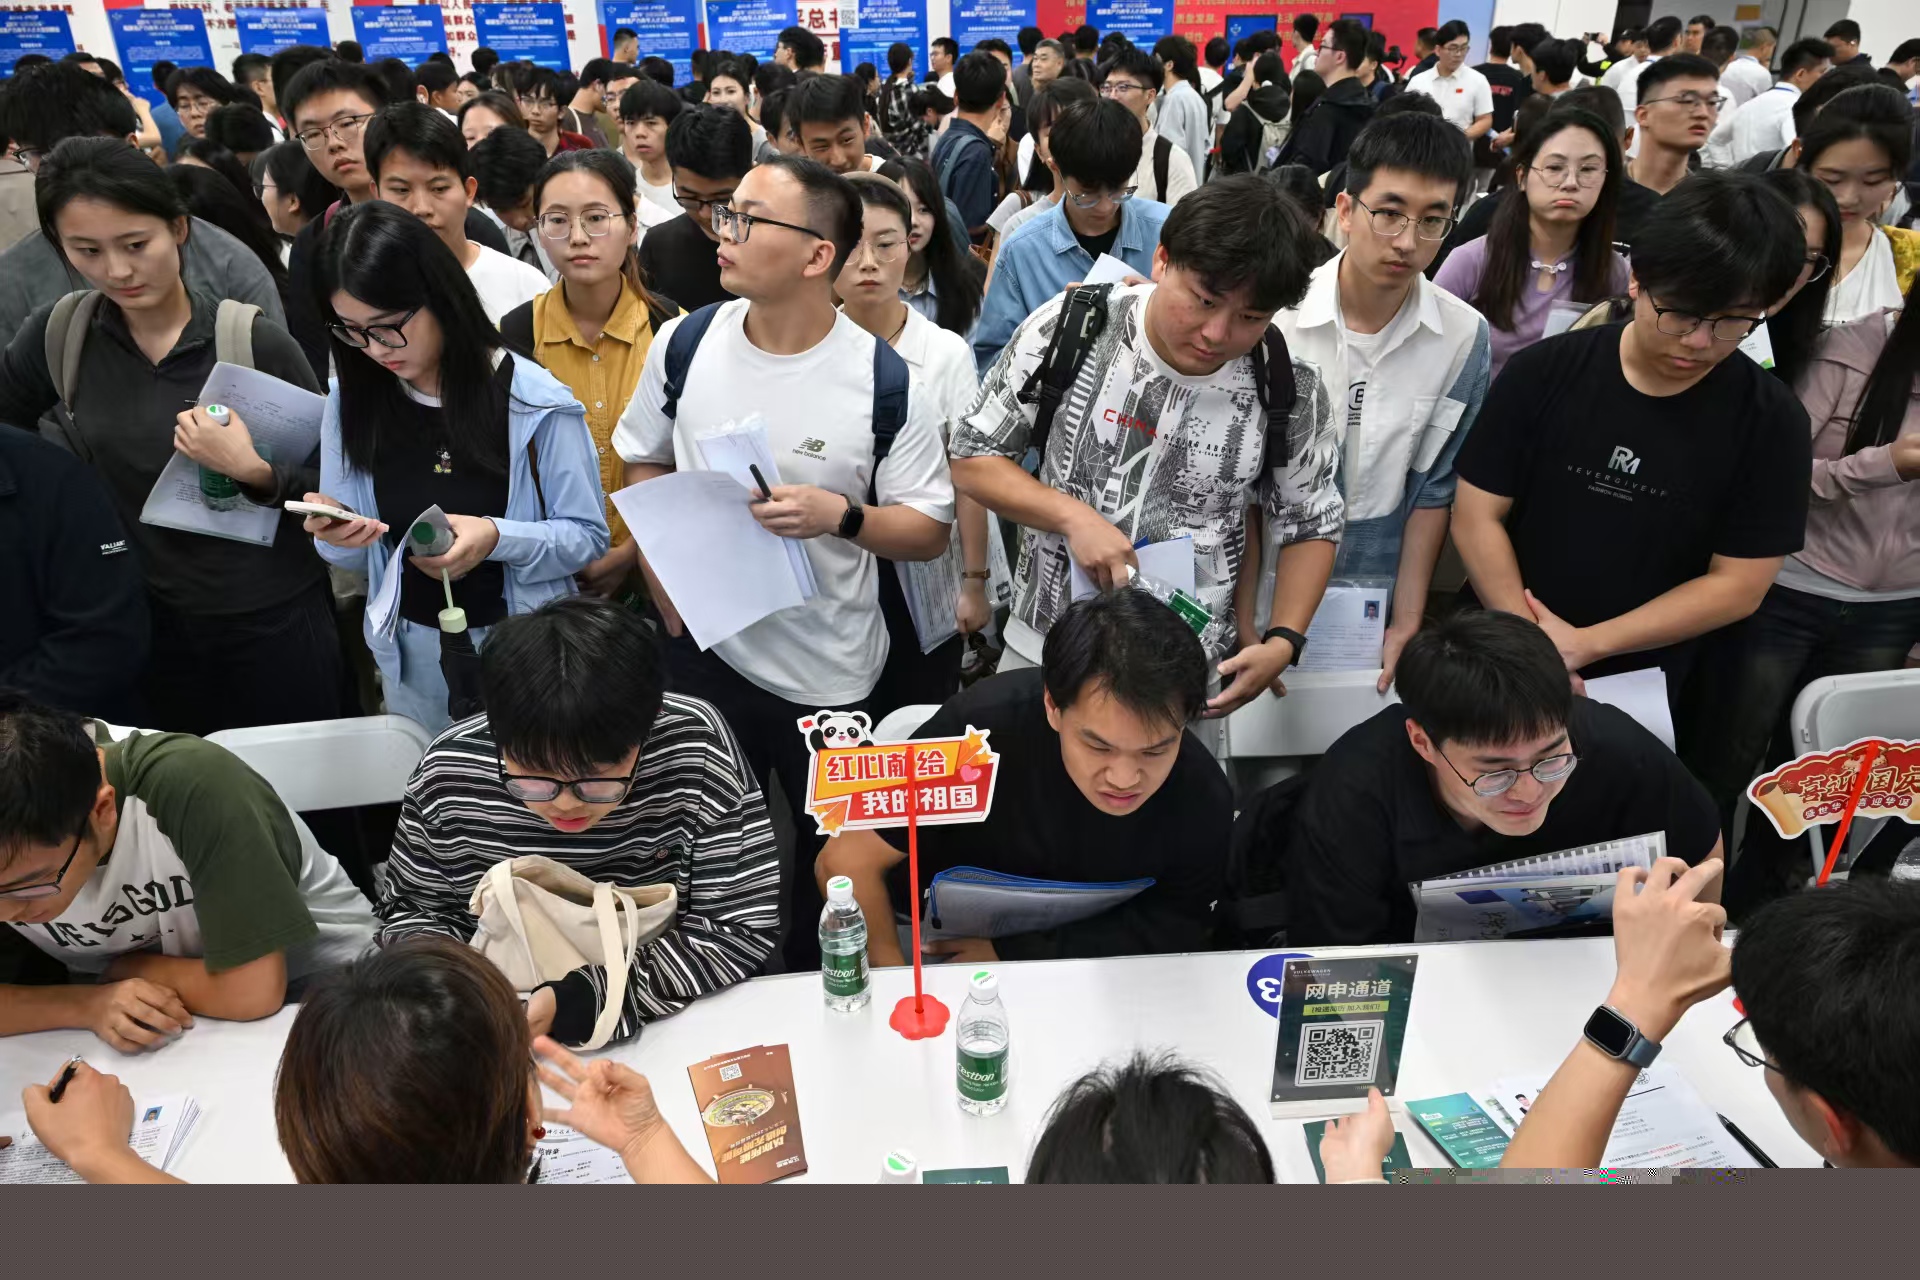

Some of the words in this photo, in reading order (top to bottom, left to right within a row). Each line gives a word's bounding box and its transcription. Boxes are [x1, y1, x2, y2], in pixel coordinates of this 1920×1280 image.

[1103, 408, 1158, 439] CHINA
[825, 749, 949, 782] 红心献给
[861, 784, 978, 816] 我的祖国
[1804, 796, 1912, 819] 盛世华喜迎华诞
[1304, 979, 1393, 1001] 网申通道
